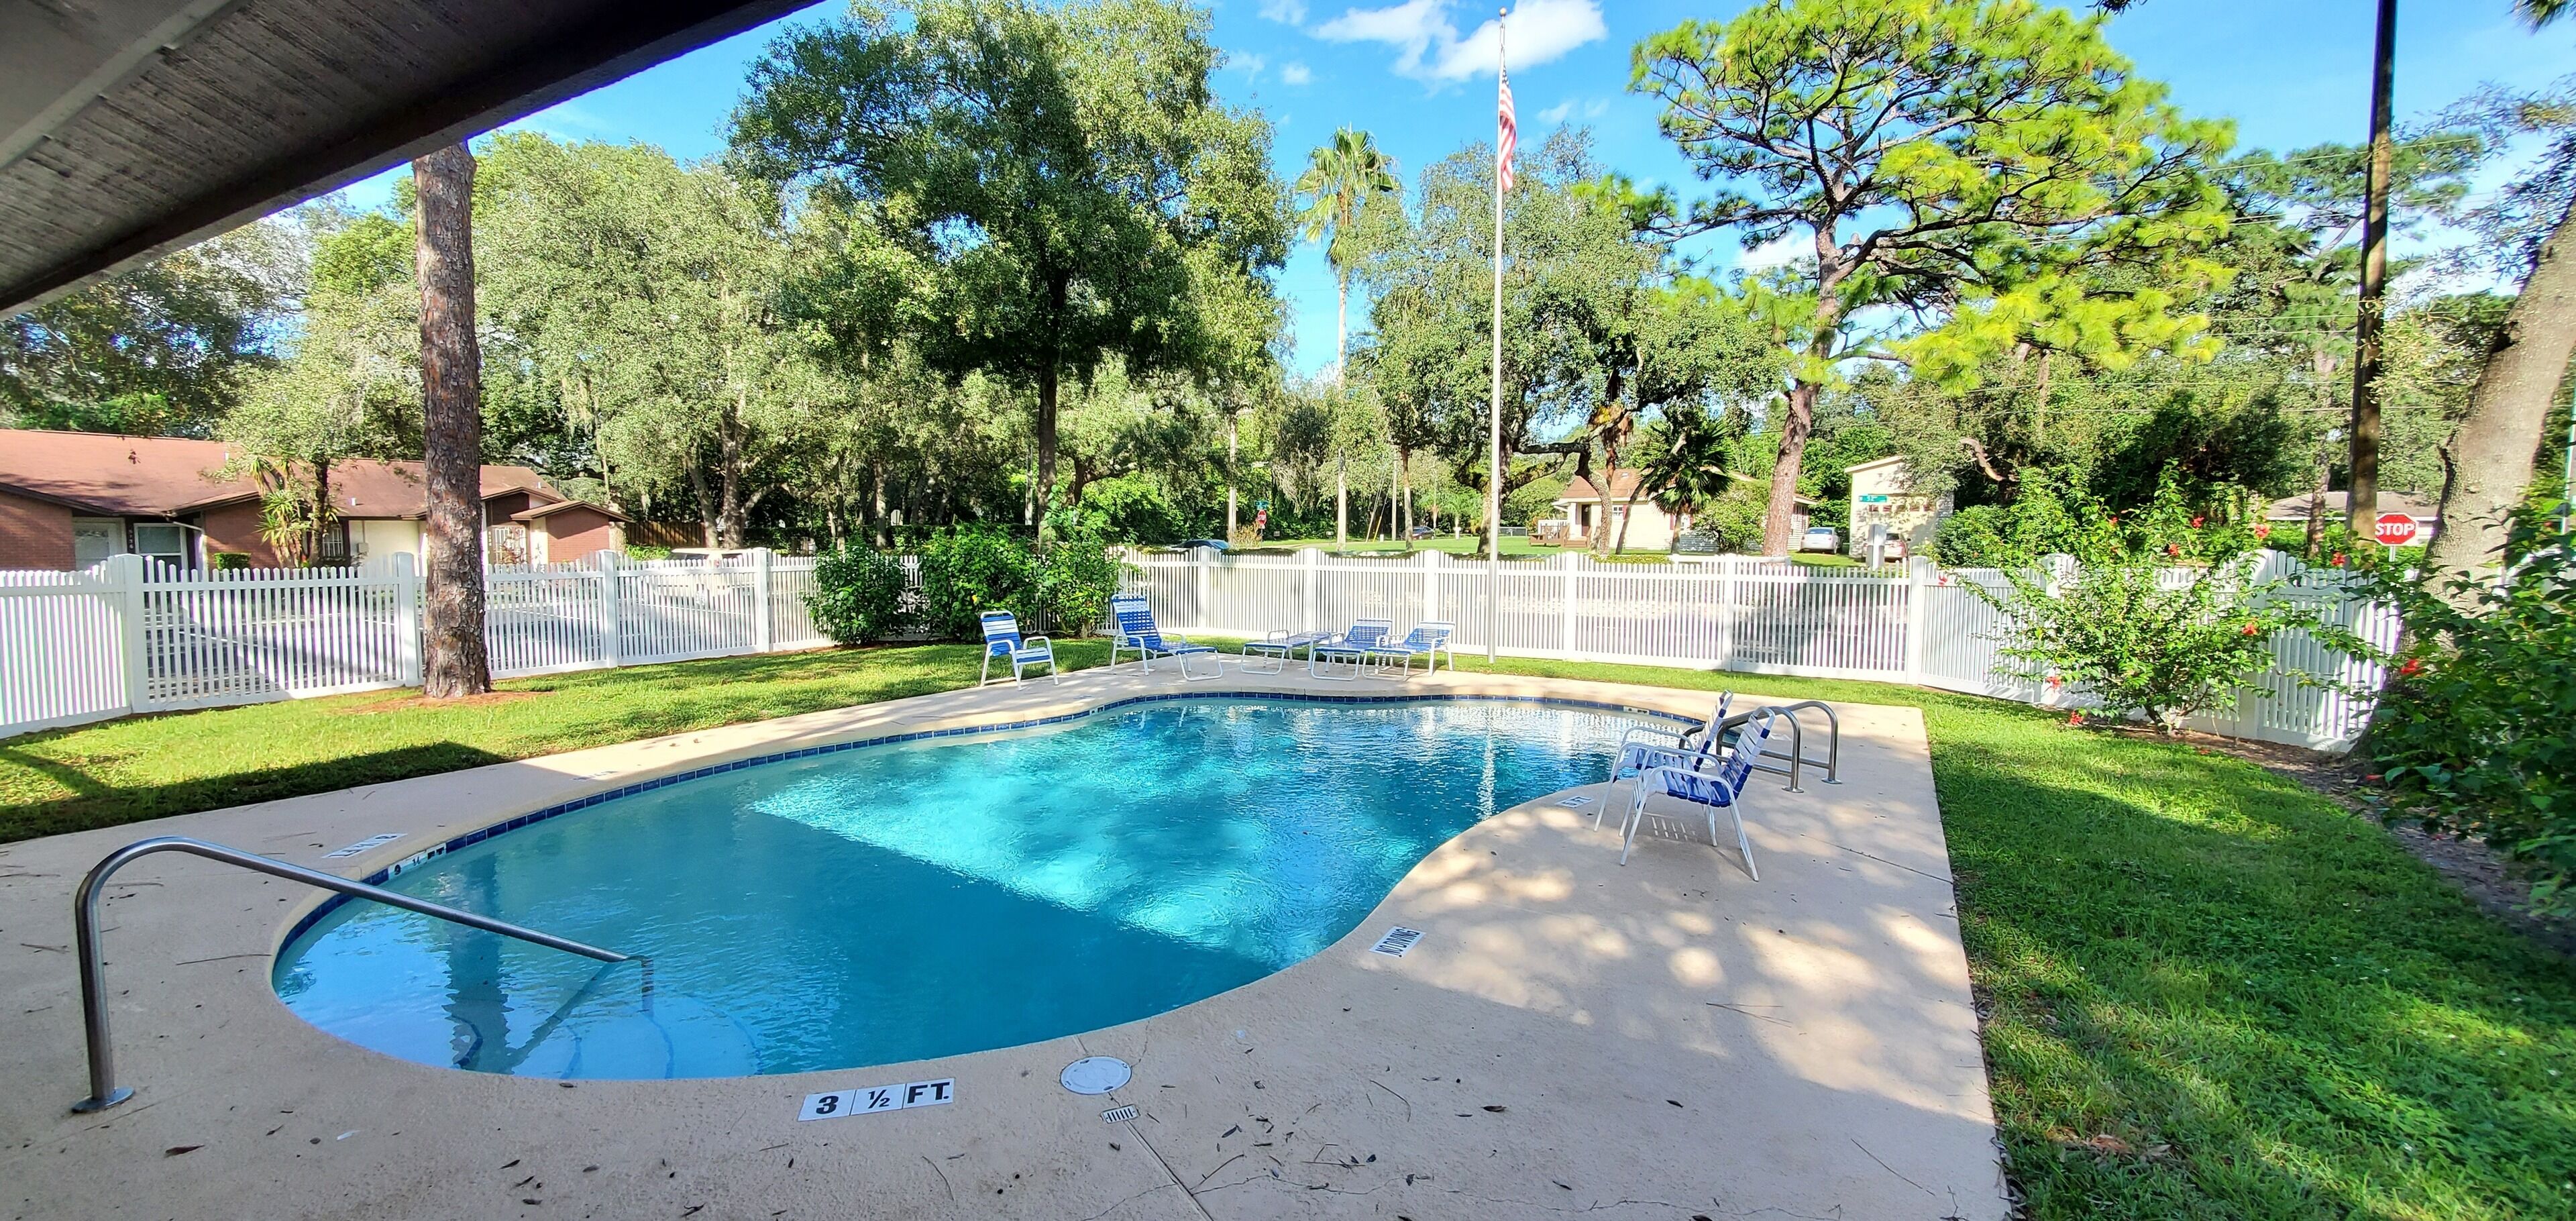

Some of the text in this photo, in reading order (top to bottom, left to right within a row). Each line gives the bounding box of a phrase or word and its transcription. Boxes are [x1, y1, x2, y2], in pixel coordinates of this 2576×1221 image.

[2375, 523, 2415, 536] STOP
[1375, 928, 1420, 956] NO DIVING
[816, 1095, 839, 1114] 3
